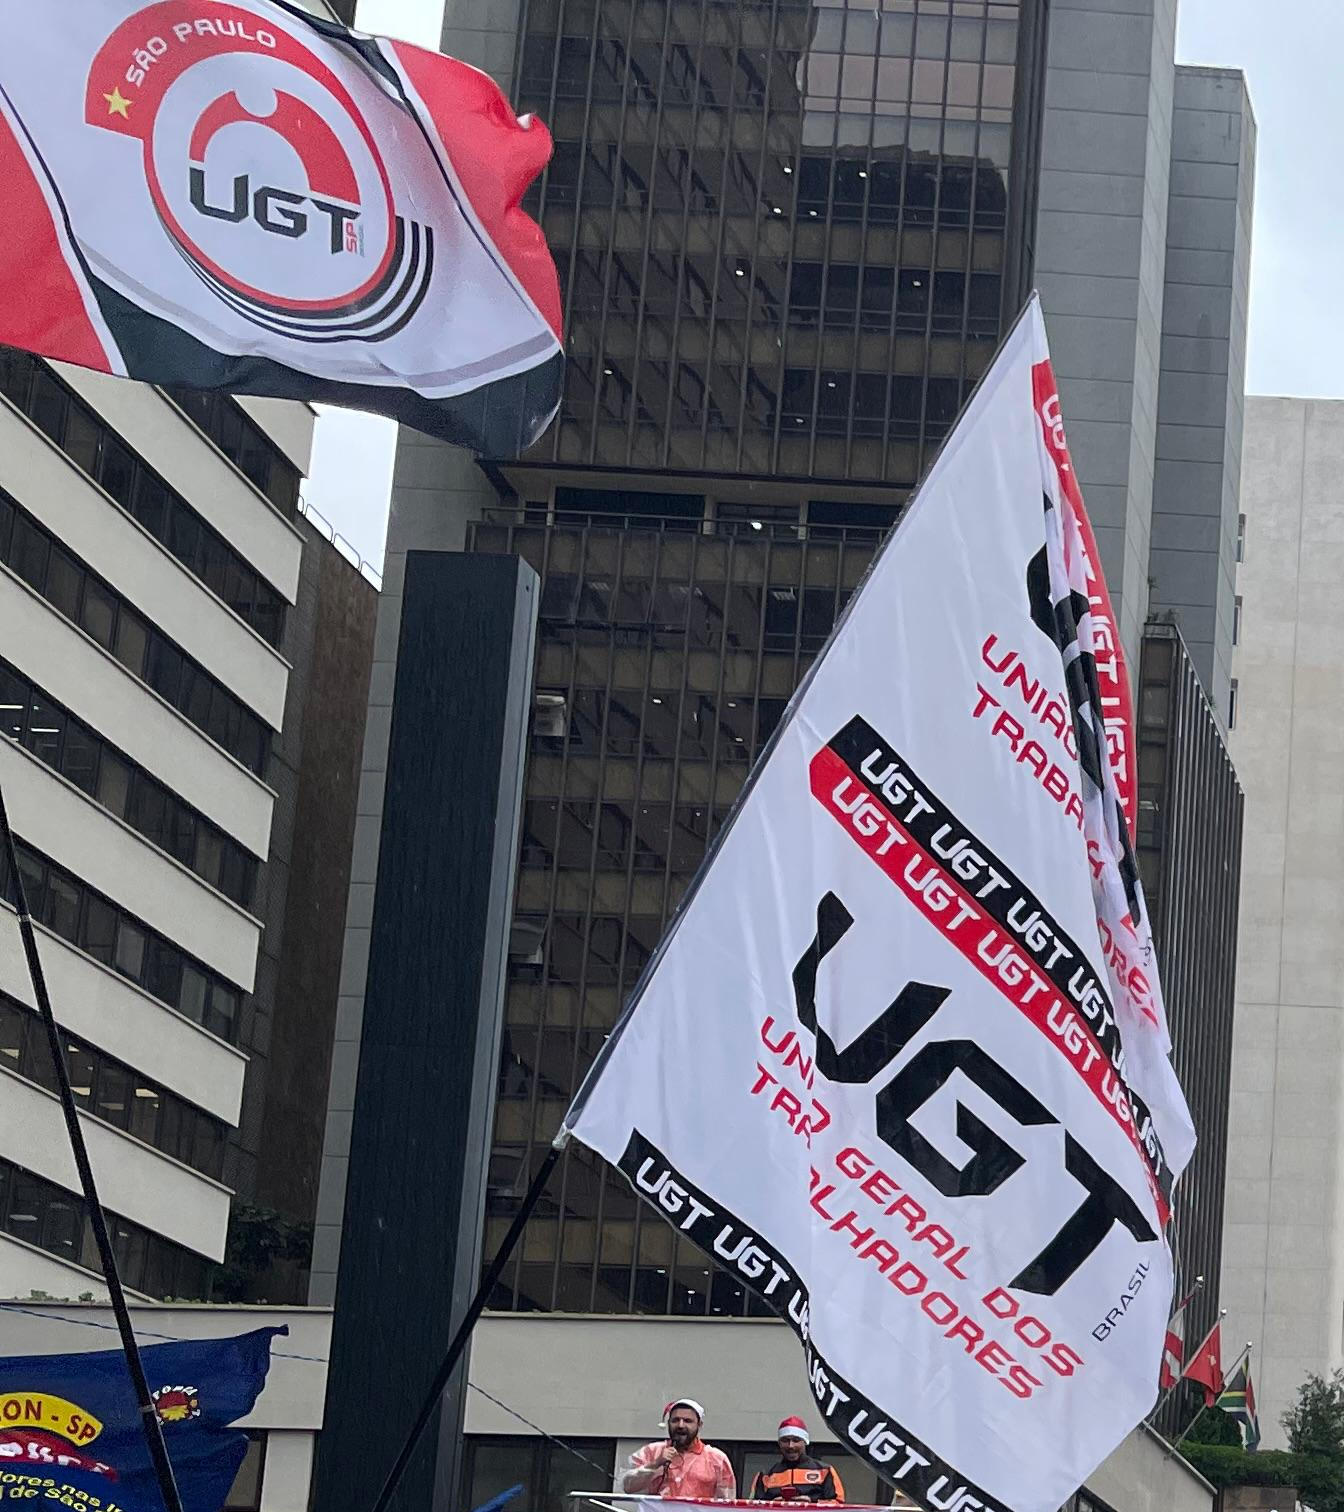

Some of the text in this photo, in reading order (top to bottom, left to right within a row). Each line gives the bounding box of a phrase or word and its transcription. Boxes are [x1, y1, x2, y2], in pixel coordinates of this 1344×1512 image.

[125, 18, 277, 89] SÃO PAULO
[189, 167, 360, 255] UGT
[832, 776, 907, 855] UGT
[904, 854, 981, 930] UGT
[977, 929, 1050, 1004] UGT
[1046, 1000, 1101, 1072] UGT
[861, 749, 935, 823] UGT
[931, 824, 1011, 897] UGT
[1007, 897, 1073, 969] UGT
[1068, 966, 1114, 1036] UGT
[793, 891, 1157, 1295] UGT
[636, 1157, 715, 1231] UGT
[713, 1224, 792, 1295] UGT
[807, 1349, 850, 1416] UGT
[849, 1410, 930, 1479] UGT
[835, 1147, 1084, 1377] GERAL DOS
[1092, 1257, 1153, 1343] BRASIL
[0, 1400, 97, 1441] ON SP
[61, 1484, 101, 1506] nas
